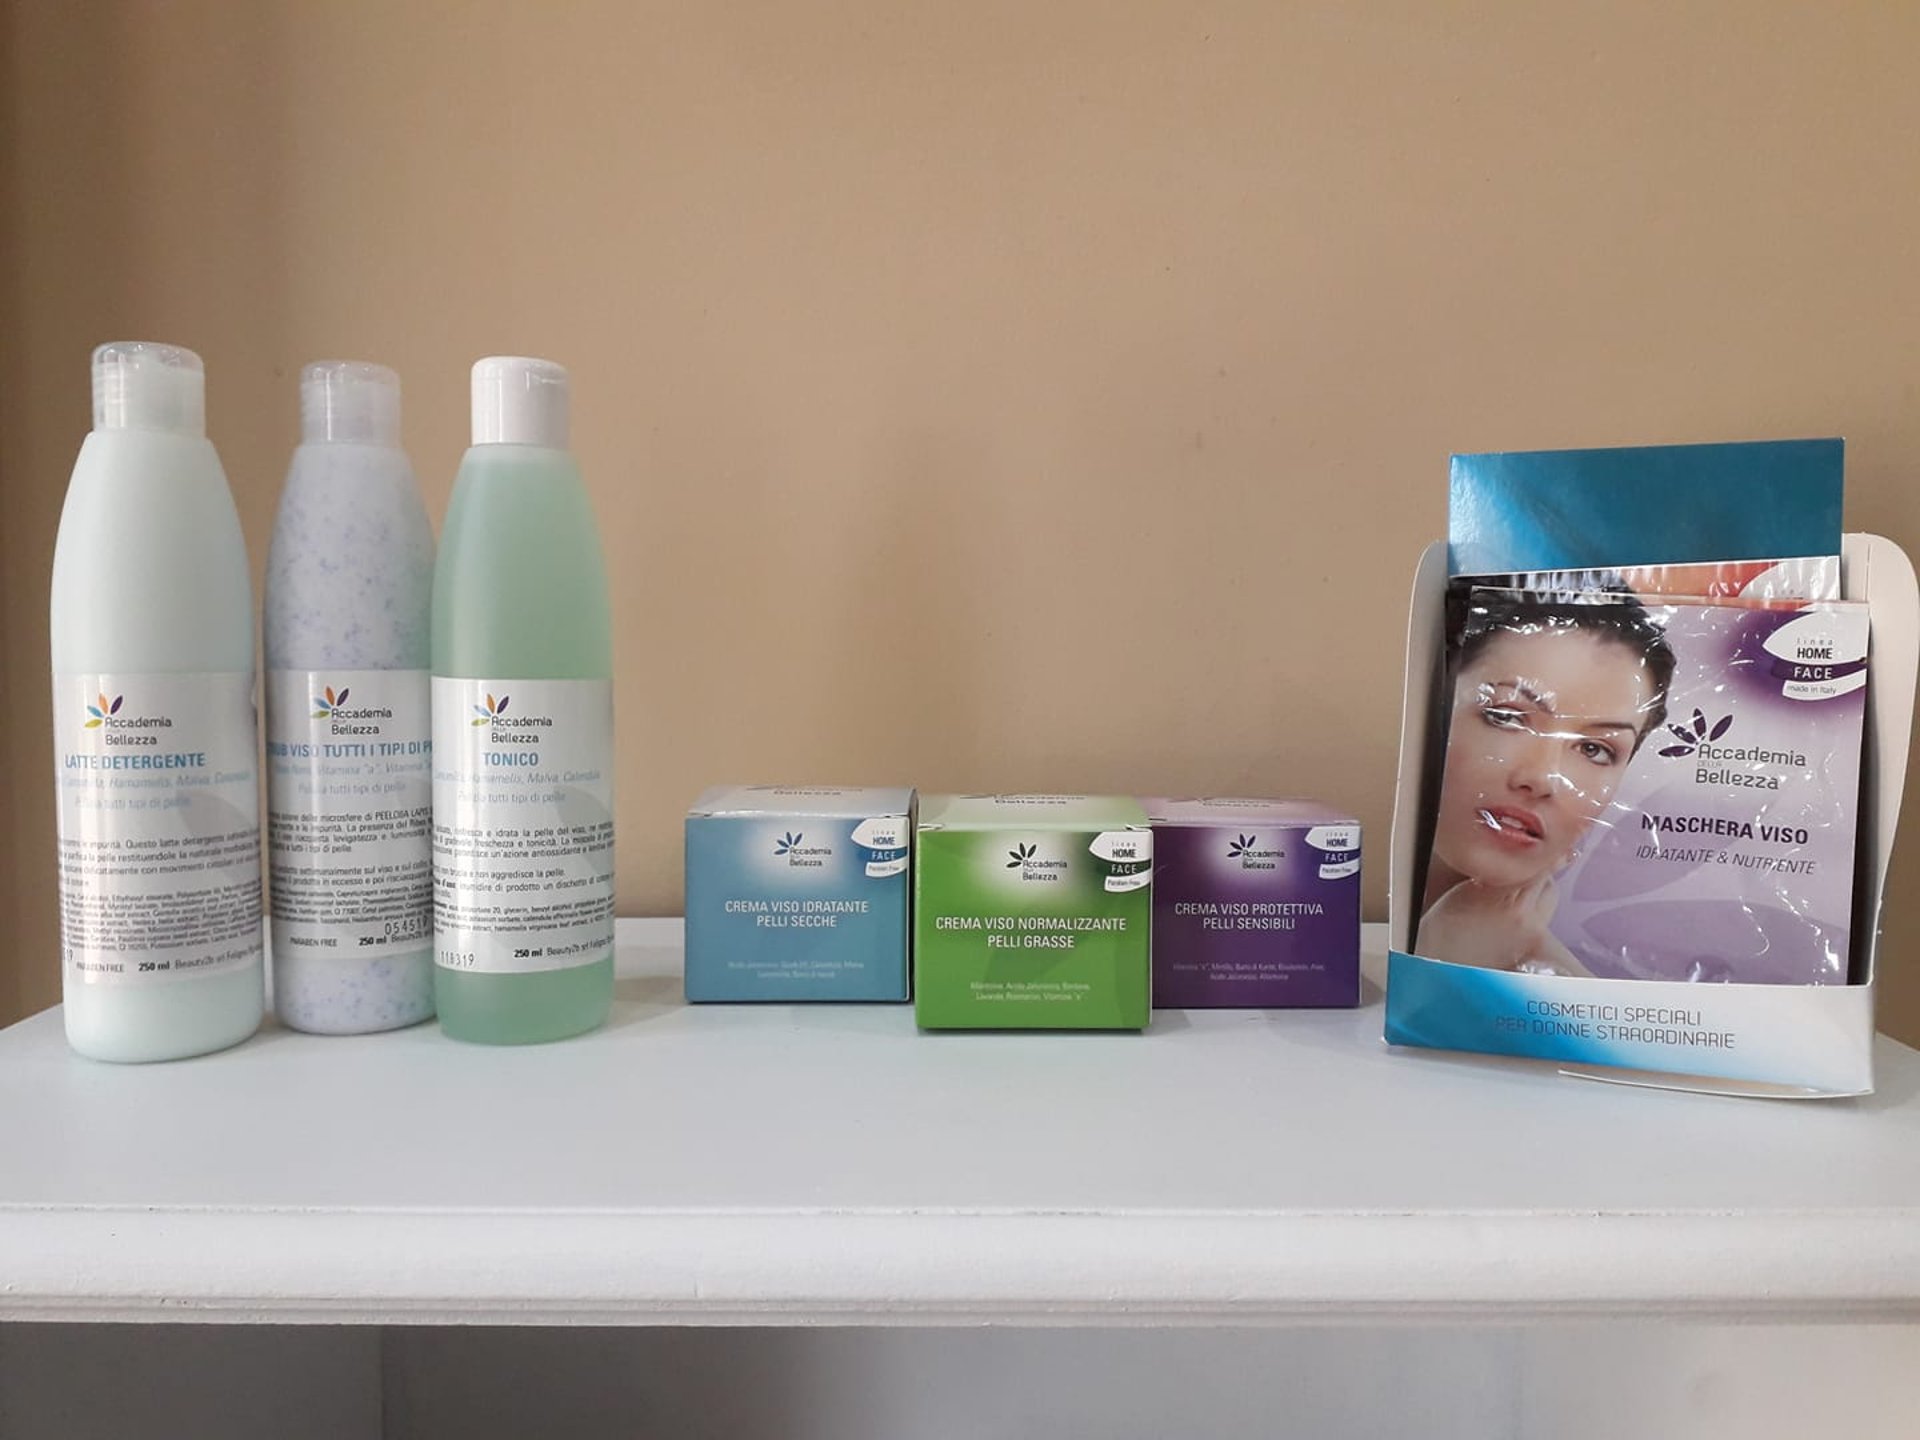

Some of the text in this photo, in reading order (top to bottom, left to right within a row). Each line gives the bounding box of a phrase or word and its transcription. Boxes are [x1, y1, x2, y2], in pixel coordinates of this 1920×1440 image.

[1797, 647, 1833, 659] HOME
[1794, 667, 1833, 679] FACE
[1811, 685, 1818, 693] in
[1820, 686, 1837, 695] Italy
[331, 707, 392, 719] Accademia
[104, 716, 172, 728] Accademia
[491, 715, 552, 727] Accademia
[331, 724, 380, 735] Bellezza
[105, 734, 157, 745] Bellezza
[491, 732, 539, 743] Bellezza
[323, 744, 365, 758] TUTTI
[370, 744, 374, 757] I
[379, 742, 404, 756] TIPI
[409, 741, 421, 754] DI
[1698, 743, 1806, 767] Accademia
[64, 752, 206, 770] LATTE DETERGENTE
[484, 752, 539, 766] TONICO
[1696, 768, 1779, 790] Bellezza
[530, 792, 540, 802] di
[1641, 813, 1809, 845] MASCHERA VISO
[126, 839, 158, 849] Questo
[872, 836, 896, 846] HOME
[1326, 838, 1349, 847] HOME
[789, 847, 832, 856] Accademia
[872, 850, 896, 861] FACE
[1112, 848, 1137, 858] HOME
[1243, 849, 1285, 858] Accademia
[1325, 852, 1349, 862] FACE
[789, 858, 823, 867] Bellezza
[1023, 859, 1068, 869] Accademia
[1243, 861, 1275, 870] Bellezza
[1636, 844, 1816, 875] IDRATANTE & NUTRIENTE
[1111, 863, 1137, 874] FACE
[1023, 872, 1058, 881] Bellezza
[725, 900, 869, 913] CREMA VISO IDRATANTE
[1175, 903, 1324, 916] CREMA VISO PROTETTIVA
[757, 915, 837, 928] PELLI SECCHE
[936, 916, 1127, 931] CREMA VISO NORMALIZZANTE
[1203, 917, 1296, 930] PELLI SENSIBILI
[359, 937, 374, 946] 250
[376, 936, 387, 945] ml
[987, 935, 1075, 948] PELLI GRASSE
[514, 949, 530, 958] 250
[531, 948, 543, 957] ml
[138, 963, 155, 972] 250
[158, 960, 170, 971] ml
[1527, 999, 1701, 1026] COSMETICI SPECIALI
[1496, 1016, 1735, 1049] PER DONNE STRAORDINARIE
